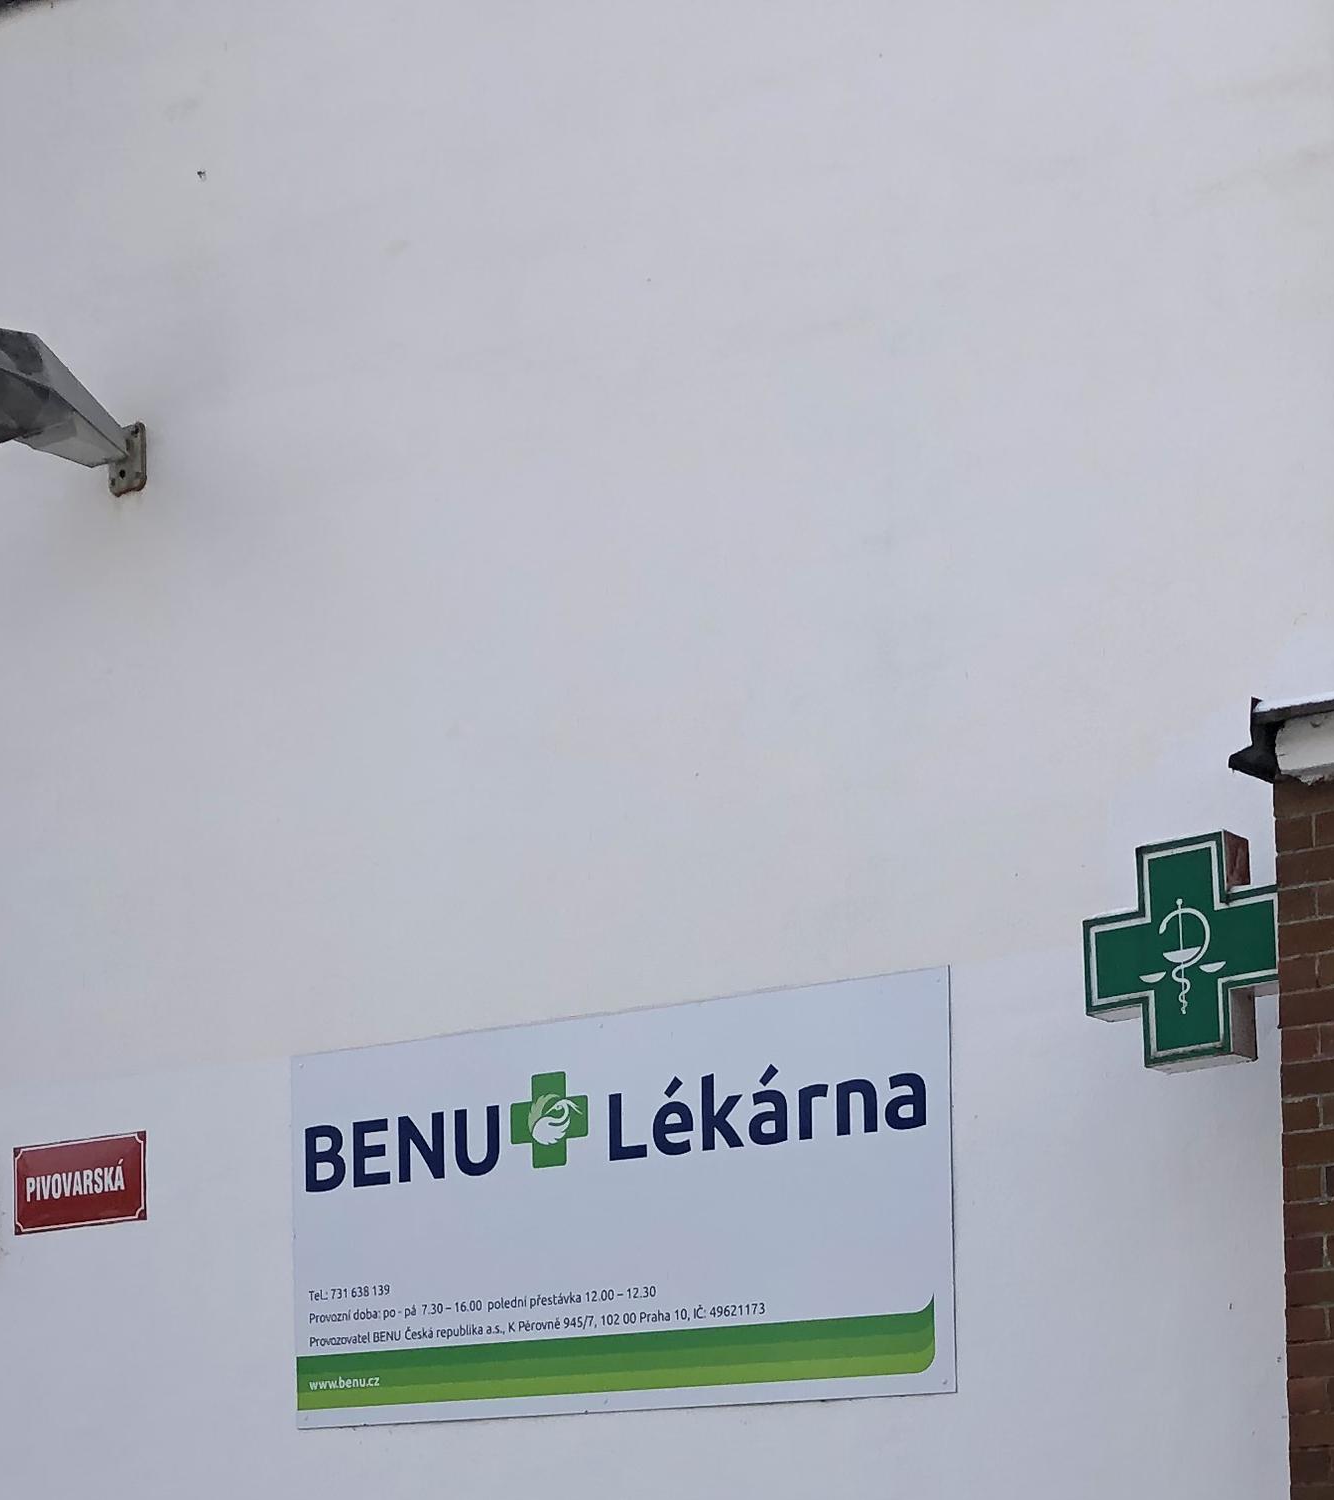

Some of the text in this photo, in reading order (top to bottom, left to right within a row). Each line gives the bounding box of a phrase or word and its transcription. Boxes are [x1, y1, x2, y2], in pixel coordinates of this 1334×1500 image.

[304, 1063, 927, 1193] BENU Lékárna
[25, 1158, 126, 1203] PIVOVARSKÁ
[309, 1310, 352, 1324] Provozní
[353, 1307, 381, 1321] doba:
[383, 1309, 396, 1321] po
[404, 1305, 417, 1319] pá
[421, 1303, 444, 1316] 7.30
[455, 1299, 483, 1313] 16.00
[487, 1296, 527, 1312] polední
[529, 1292, 582, 1309] přestávka
[585, 1288, 615, 1303] 12.00
[626, 1286, 657, 1300] 12.30
[331, 1287, 348, 1300] 731
[351, 1285, 370, 1299] 638
[372, 1284, 391, 1297] 139
[309, 1331, 371, 1347] Provozovatel
[373, 1330, 402, 1343] BENU
[404, 1326, 434, 1341] Česká
[436, 1322, 484, 1340] republika
[485, 1322, 506, 1336] a.s.,
[508, 1321, 516, 1333] K
[562, 1315, 598, 1330] 945/7,
[600, 1313, 621, 1326] 102
[622, 1312, 637, 1325] 00
[639, 1309, 671, 1324] Praha
[674, 1308, 691, 1322] 10,
[693, 1304, 707, 1319] IČ:
[709, 1302, 766, 1318] 49621173
[308, 1376, 380, 1391] www.benu.cz
